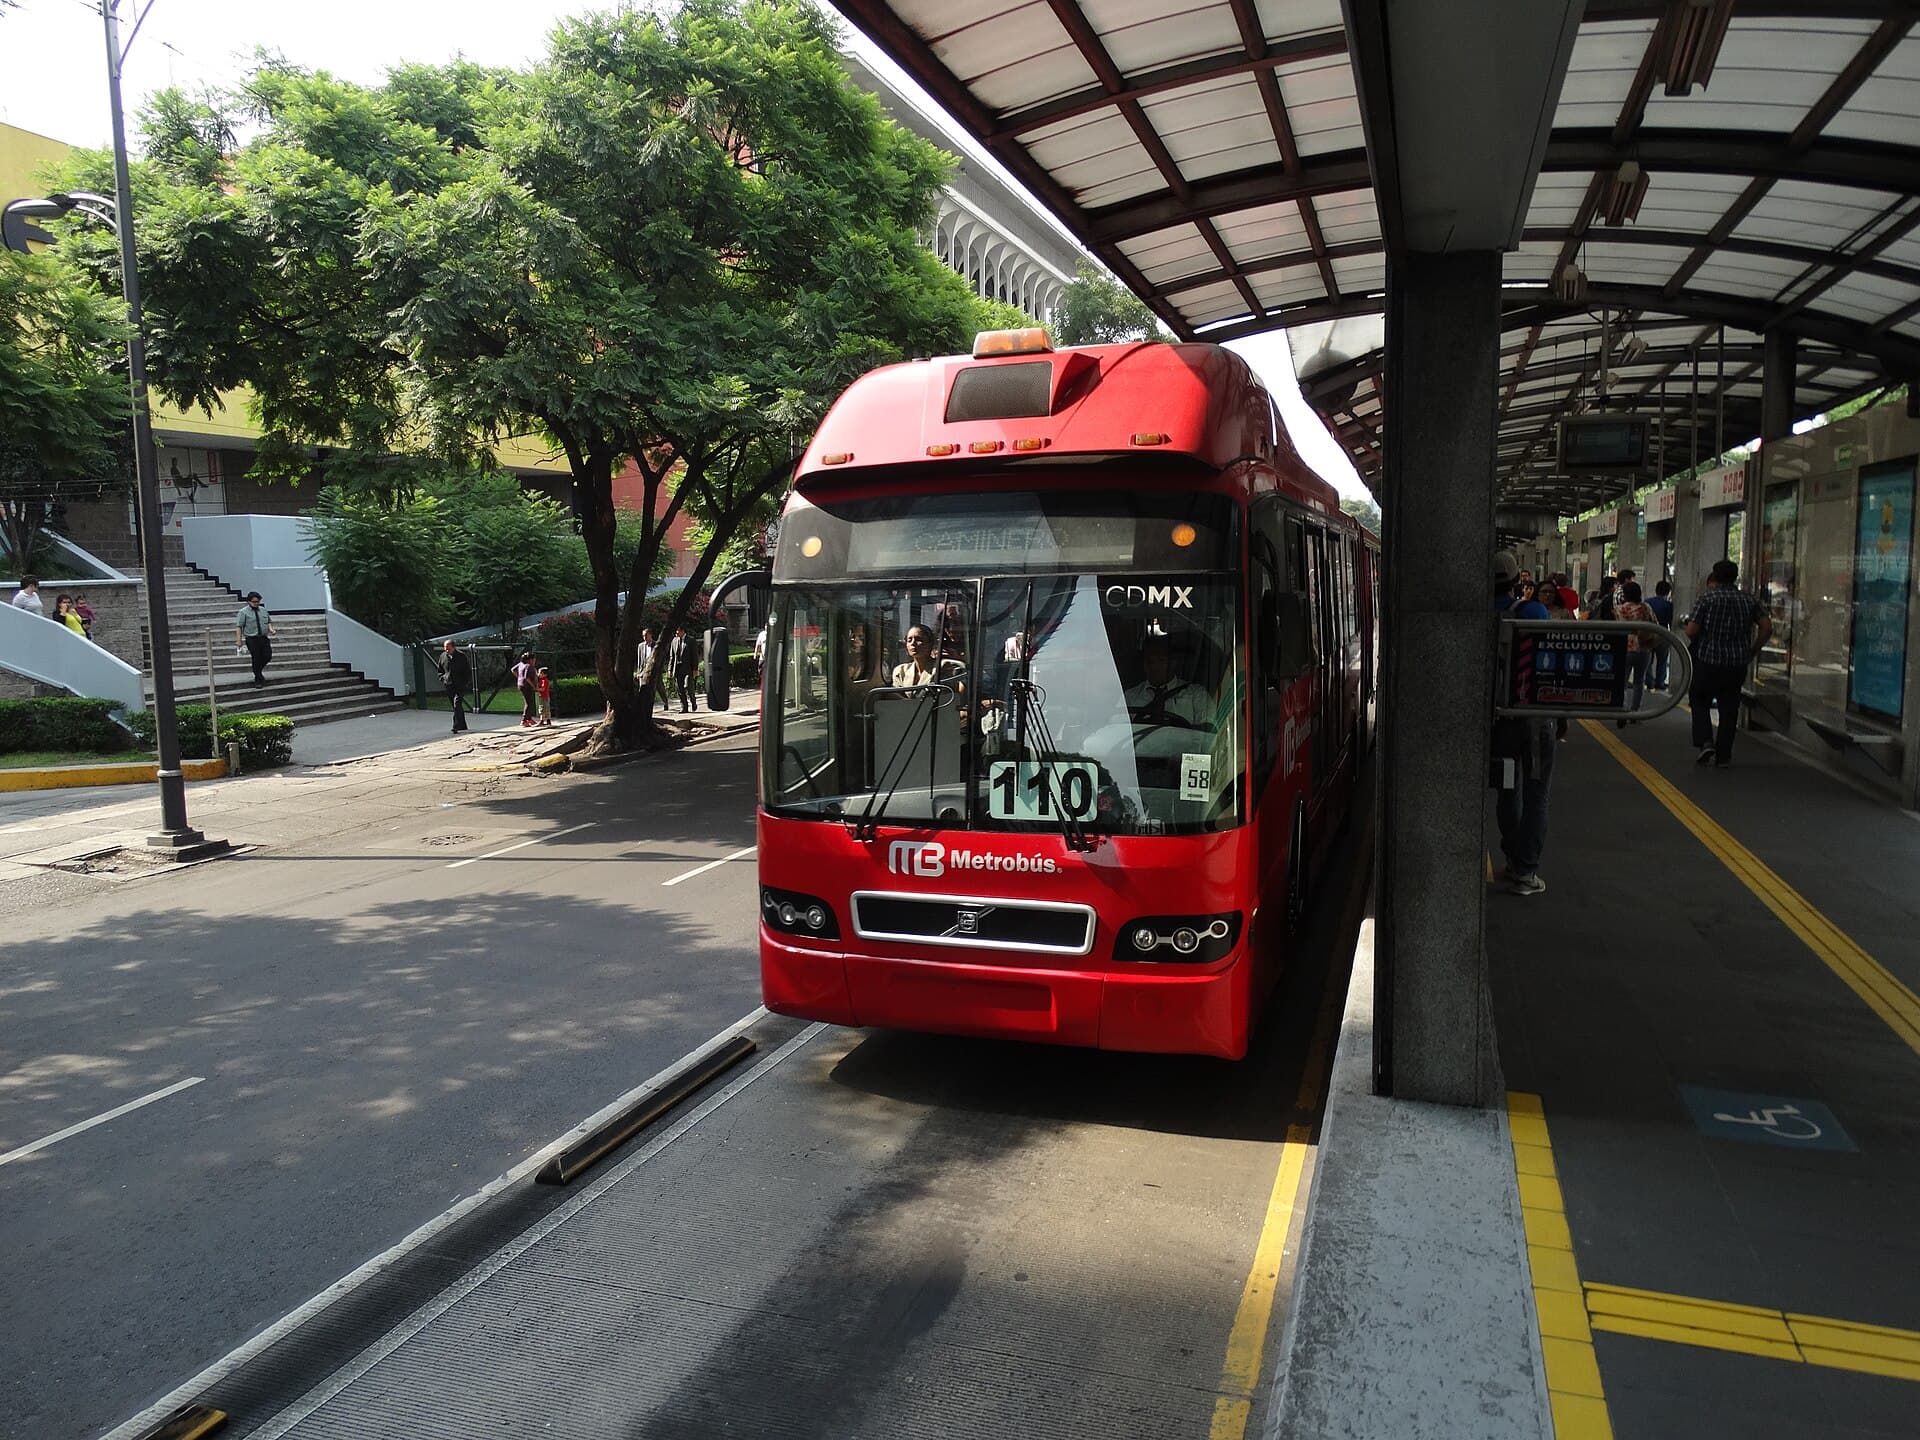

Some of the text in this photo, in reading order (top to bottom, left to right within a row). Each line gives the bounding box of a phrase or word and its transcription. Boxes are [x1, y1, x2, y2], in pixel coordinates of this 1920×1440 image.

[914, 528, 1069, 553] CAMINERO
[1105, 585, 1194, 609] CDMX
[1538, 641, 1612, 651] EXCLUSIVO
[1546, 631, 1605, 641] INGRESO
[1187, 769, 1210, 789] 58
[993, 766, 1093, 818] 110
[950, 849, 1057, 874] Metrobús
